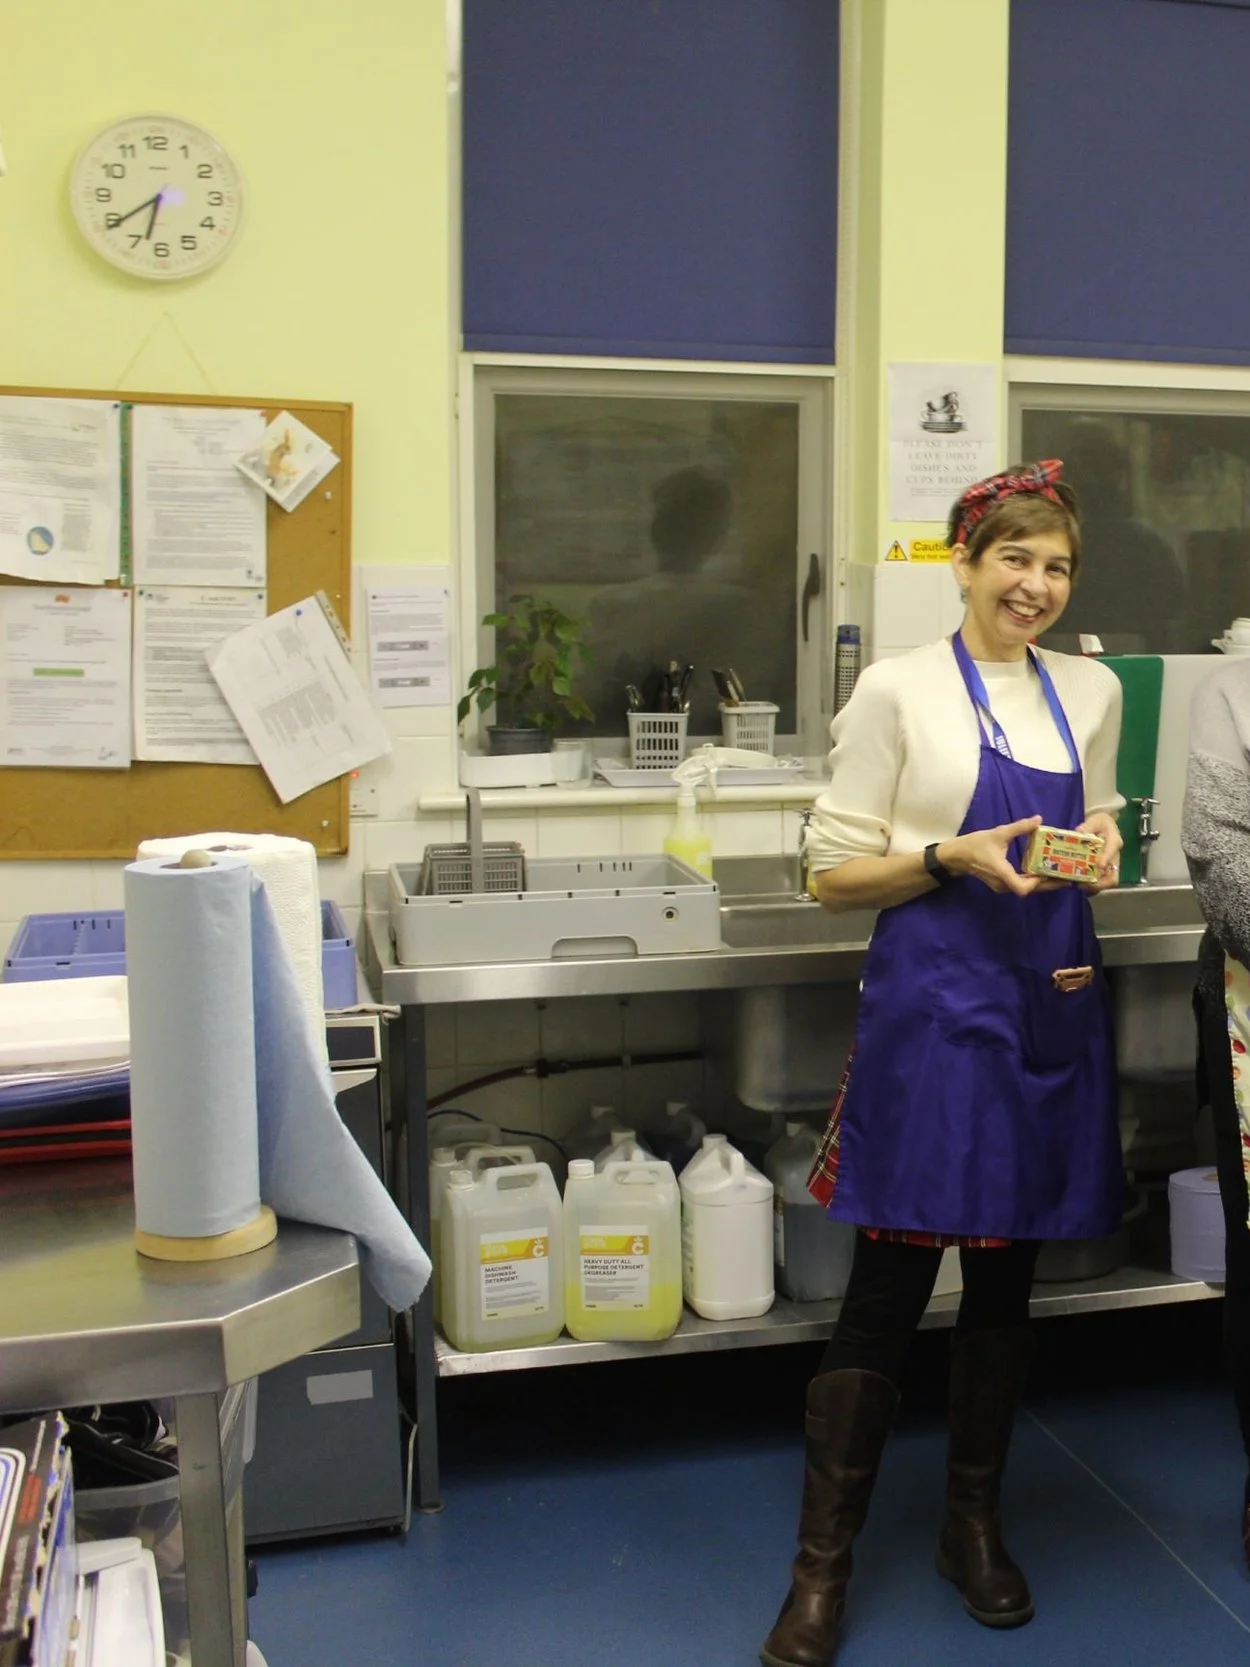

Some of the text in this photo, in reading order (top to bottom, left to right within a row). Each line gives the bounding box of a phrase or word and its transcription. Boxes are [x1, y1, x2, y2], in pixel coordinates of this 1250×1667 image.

[142, 136, 169, 151] 12
[117, 144, 136, 159] 11
[179, 145, 189, 159] 1
[101, 163, 126, 179] 10
[196, 163, 213, 179] 2
[95, 187, 112, 203] 9
[207, 191, 224, 206] 3
[104, 212, 122, 229] 8
[200, 216, 216, 230] 4
[127, 234, 143, 249] 7
[180, 235, 197, 251] 5
[154, 242, 170, 258] 6
[910, 463, 977, 472] DISHES AND
[906, 475, 934, 484] CUPS
[913, 541, 950, 552] Cautio
[484, 1265, 513, 1273] MACHINE
[484, 1275, 519, 1284] DETERGENT
